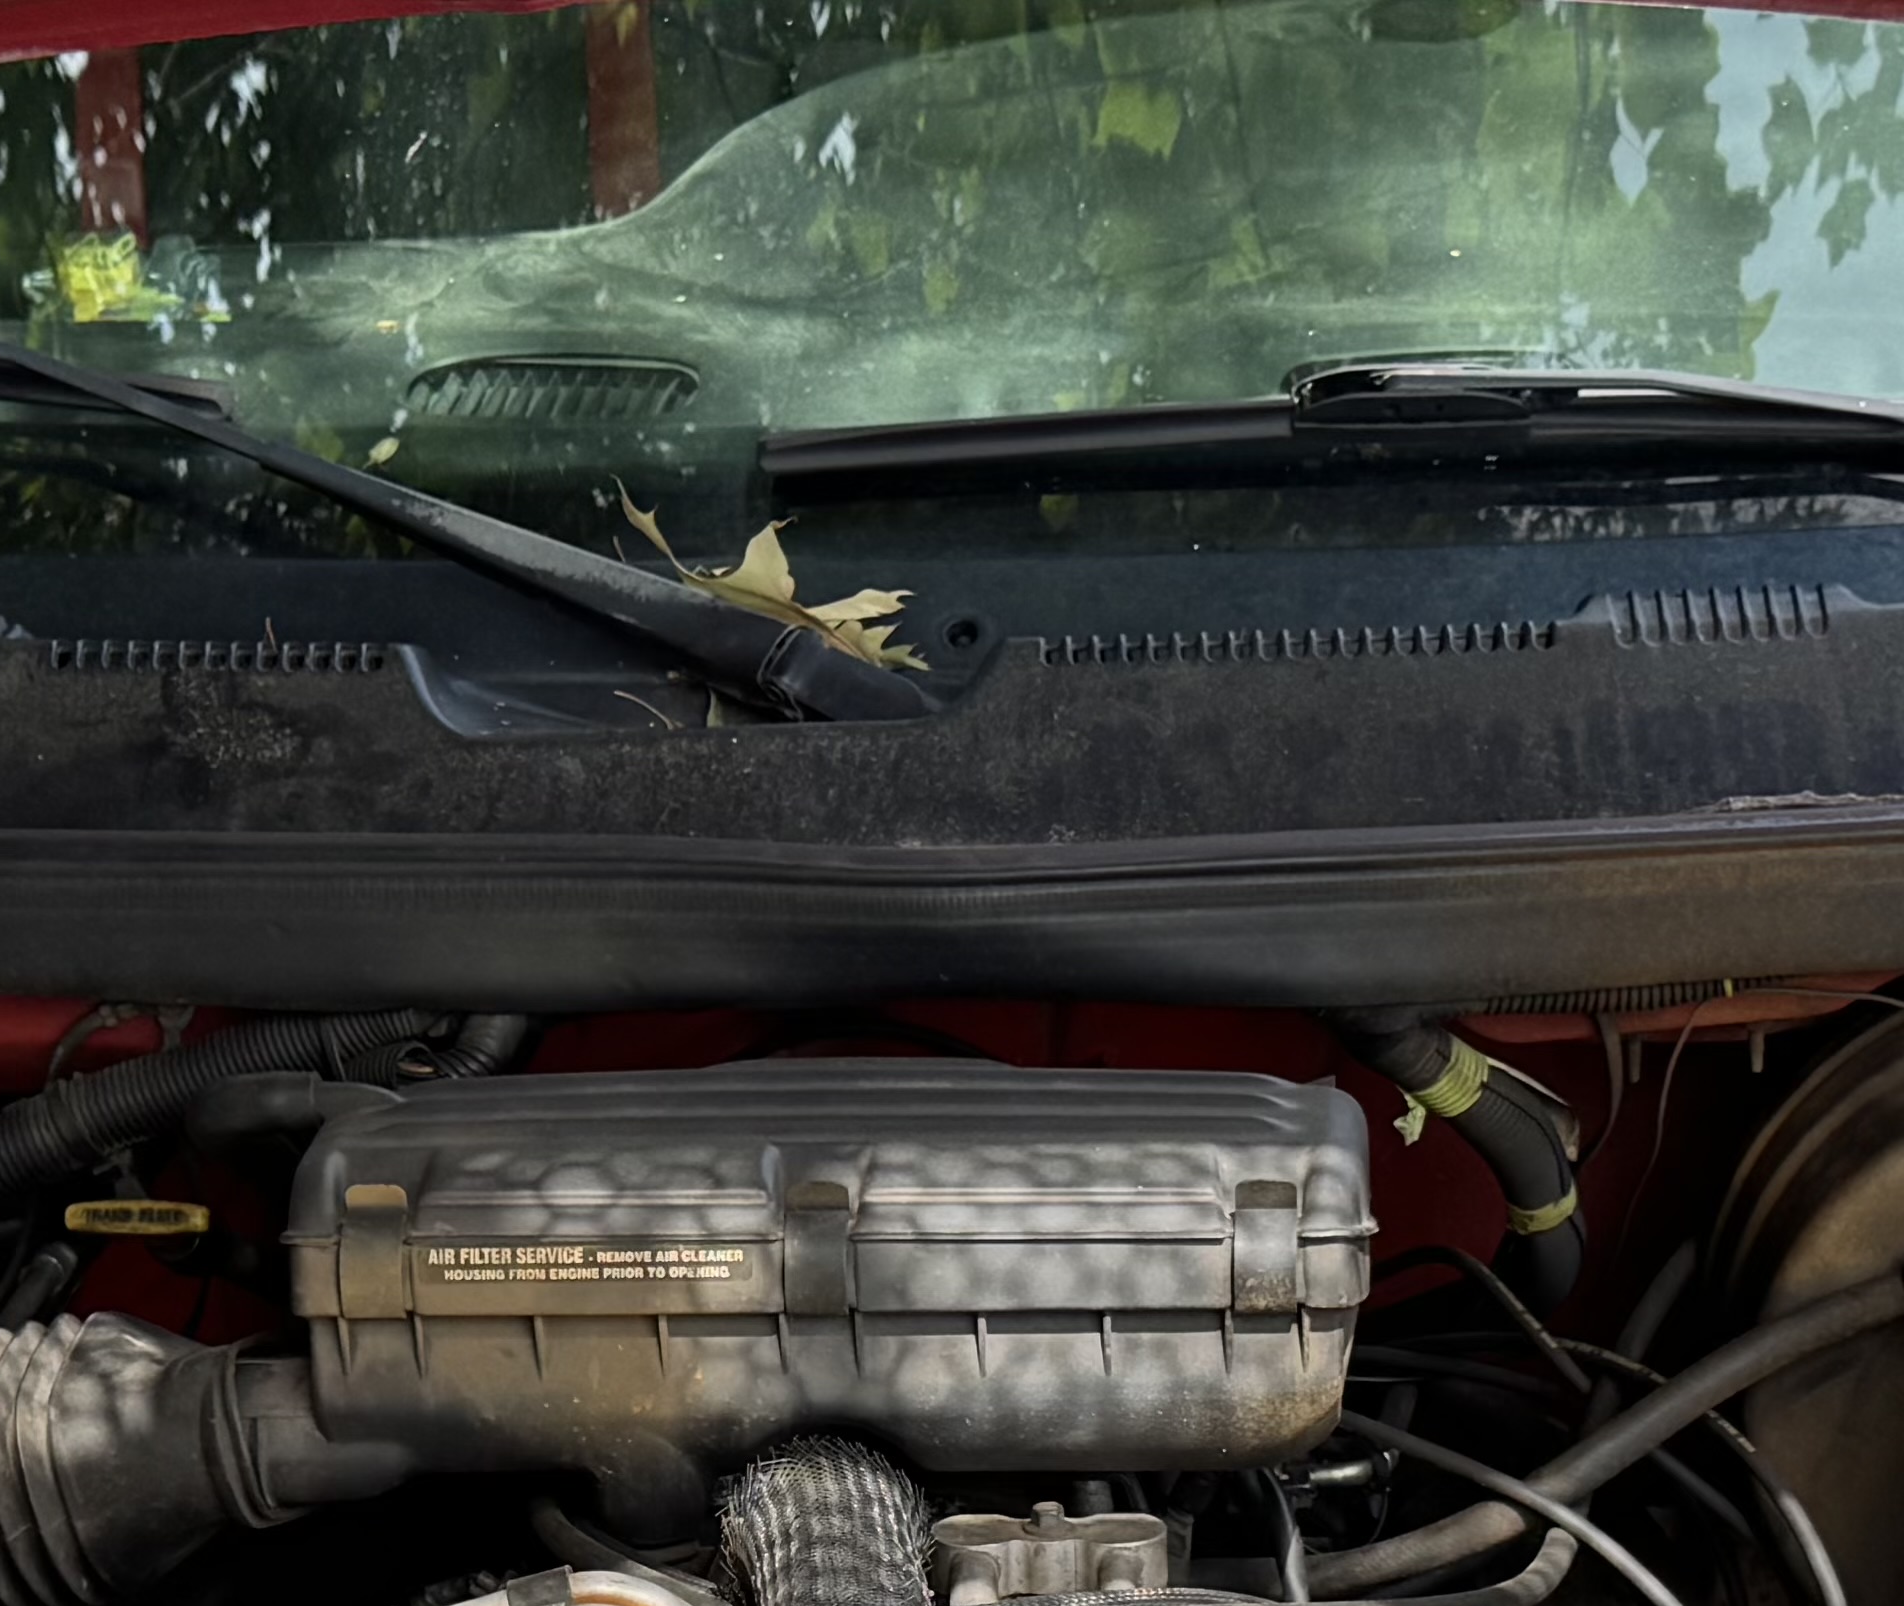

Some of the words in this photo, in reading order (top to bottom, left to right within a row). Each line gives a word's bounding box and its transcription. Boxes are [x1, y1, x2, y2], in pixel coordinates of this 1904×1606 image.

[428, 1247, 455, 1265] AIR
[460, 1247, 511, 1265] FILTER
[516, 1246, 584, 1265] SERVICE
[596, 1250, 652, 1263] REMOVE
[655, 1250, 679, 1263] AIR
[680, 1249, 744, 1263] CLEANER
[444, 1268, 506, 1281] HOUSING
[509, 1268, 546, 1280] FROM
[549, 1267, 600, 1280] ENGINE
[603, 1267, 644, 1280] PRIOR
[647, 1267, 666, 1279] TO
[668, 1266, 730, 1279] OPENING
